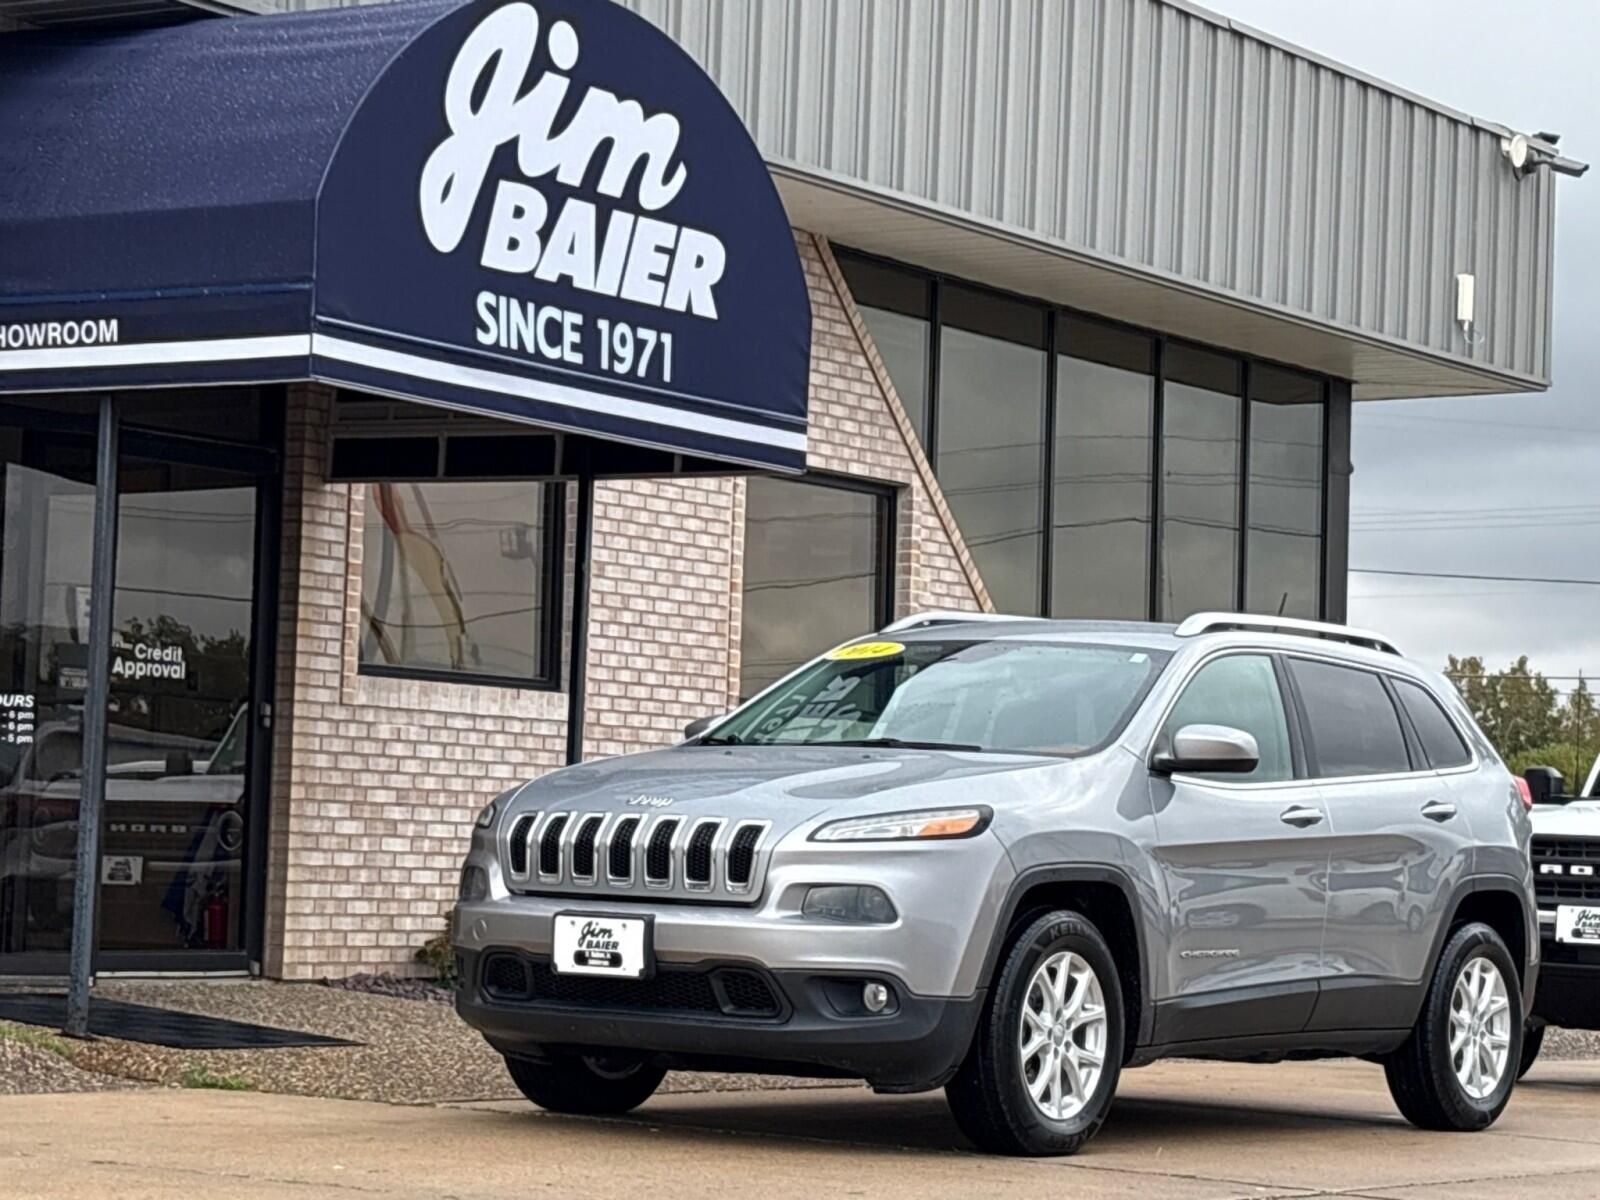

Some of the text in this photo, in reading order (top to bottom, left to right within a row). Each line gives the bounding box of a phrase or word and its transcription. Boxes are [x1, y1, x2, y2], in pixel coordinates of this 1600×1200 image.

[420, 2, 687, 252] Jim
[480, 179, 726, 320] BAIER
[476, 290, 672, 383] SINCE 1971
[134, 643, 183, 662] Credit
[112, 656, 186, 679] Approval
[577, 920, 613, 948] Jim
[586, 940, 619, 951] BAIER
